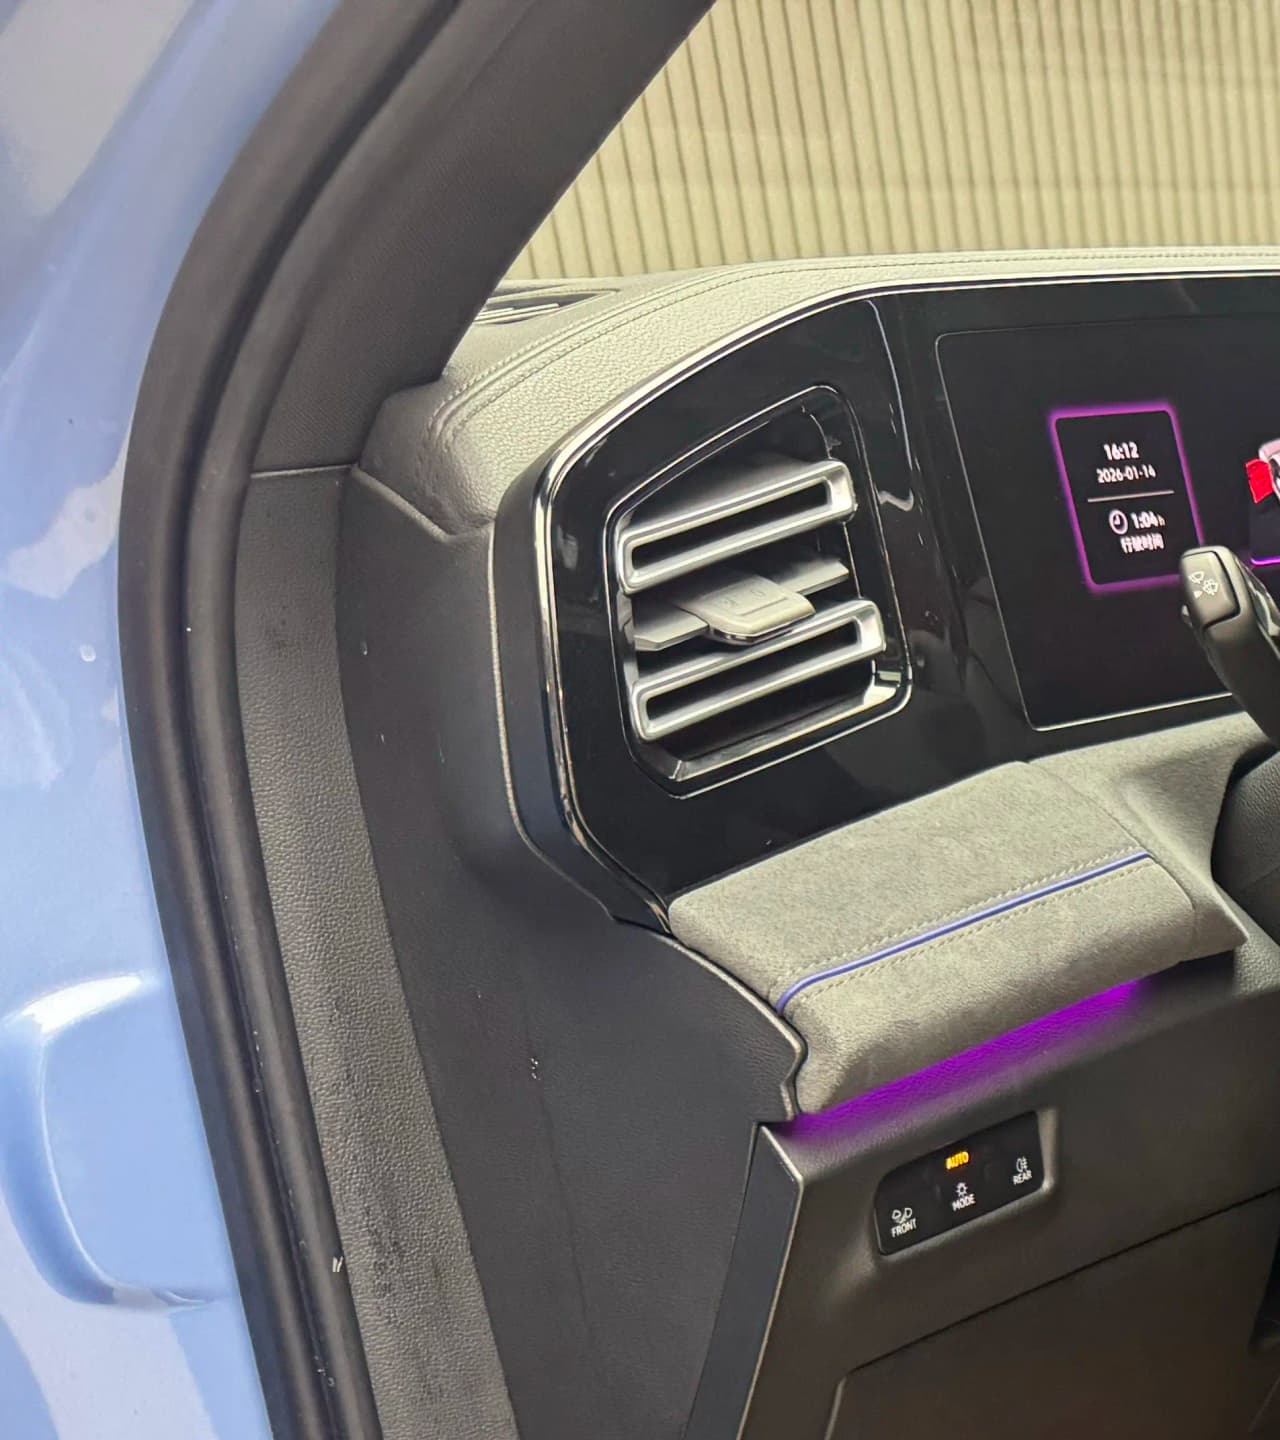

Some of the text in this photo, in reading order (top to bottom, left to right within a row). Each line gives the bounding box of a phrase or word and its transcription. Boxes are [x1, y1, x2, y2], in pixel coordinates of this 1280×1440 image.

[1103, 441, 1139, 460] 16:12
[945, 1151, 970, 1170] AUTO
[1012, 1169, 1033, 1186] REAR
[952, 1194, 976, 1212] MODE
[891, 1218, 918, 1238] FRONT
